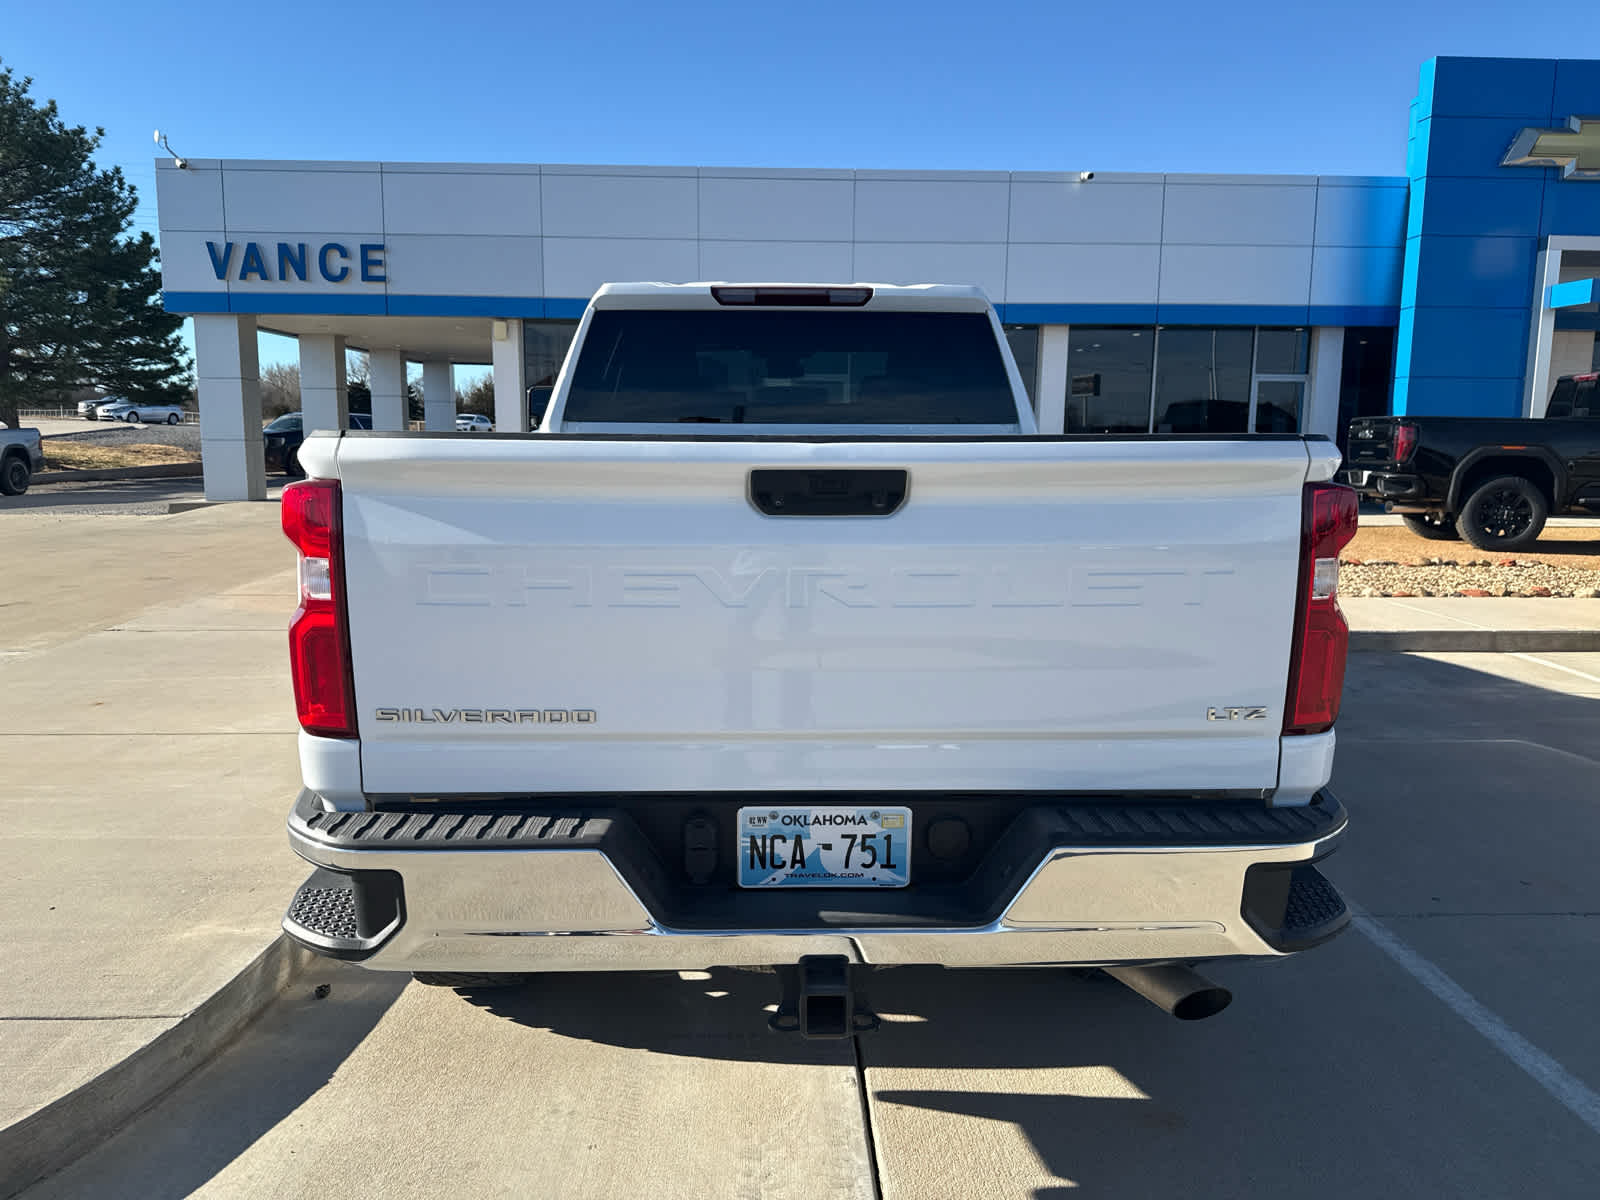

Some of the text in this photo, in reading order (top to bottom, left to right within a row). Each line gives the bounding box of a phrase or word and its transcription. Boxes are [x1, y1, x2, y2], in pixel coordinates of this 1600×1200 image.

[205, 241, 388, 282] VANCE
[415, 563, 1236, 609] CHEVROLET
[375, 707, 597, 724] SILVERADO
[1206, 705, 1267, 721] LTZ
[781, 814, 868, 828] OKLAHOMA
[750, 833, 896, 869] NCA 751
